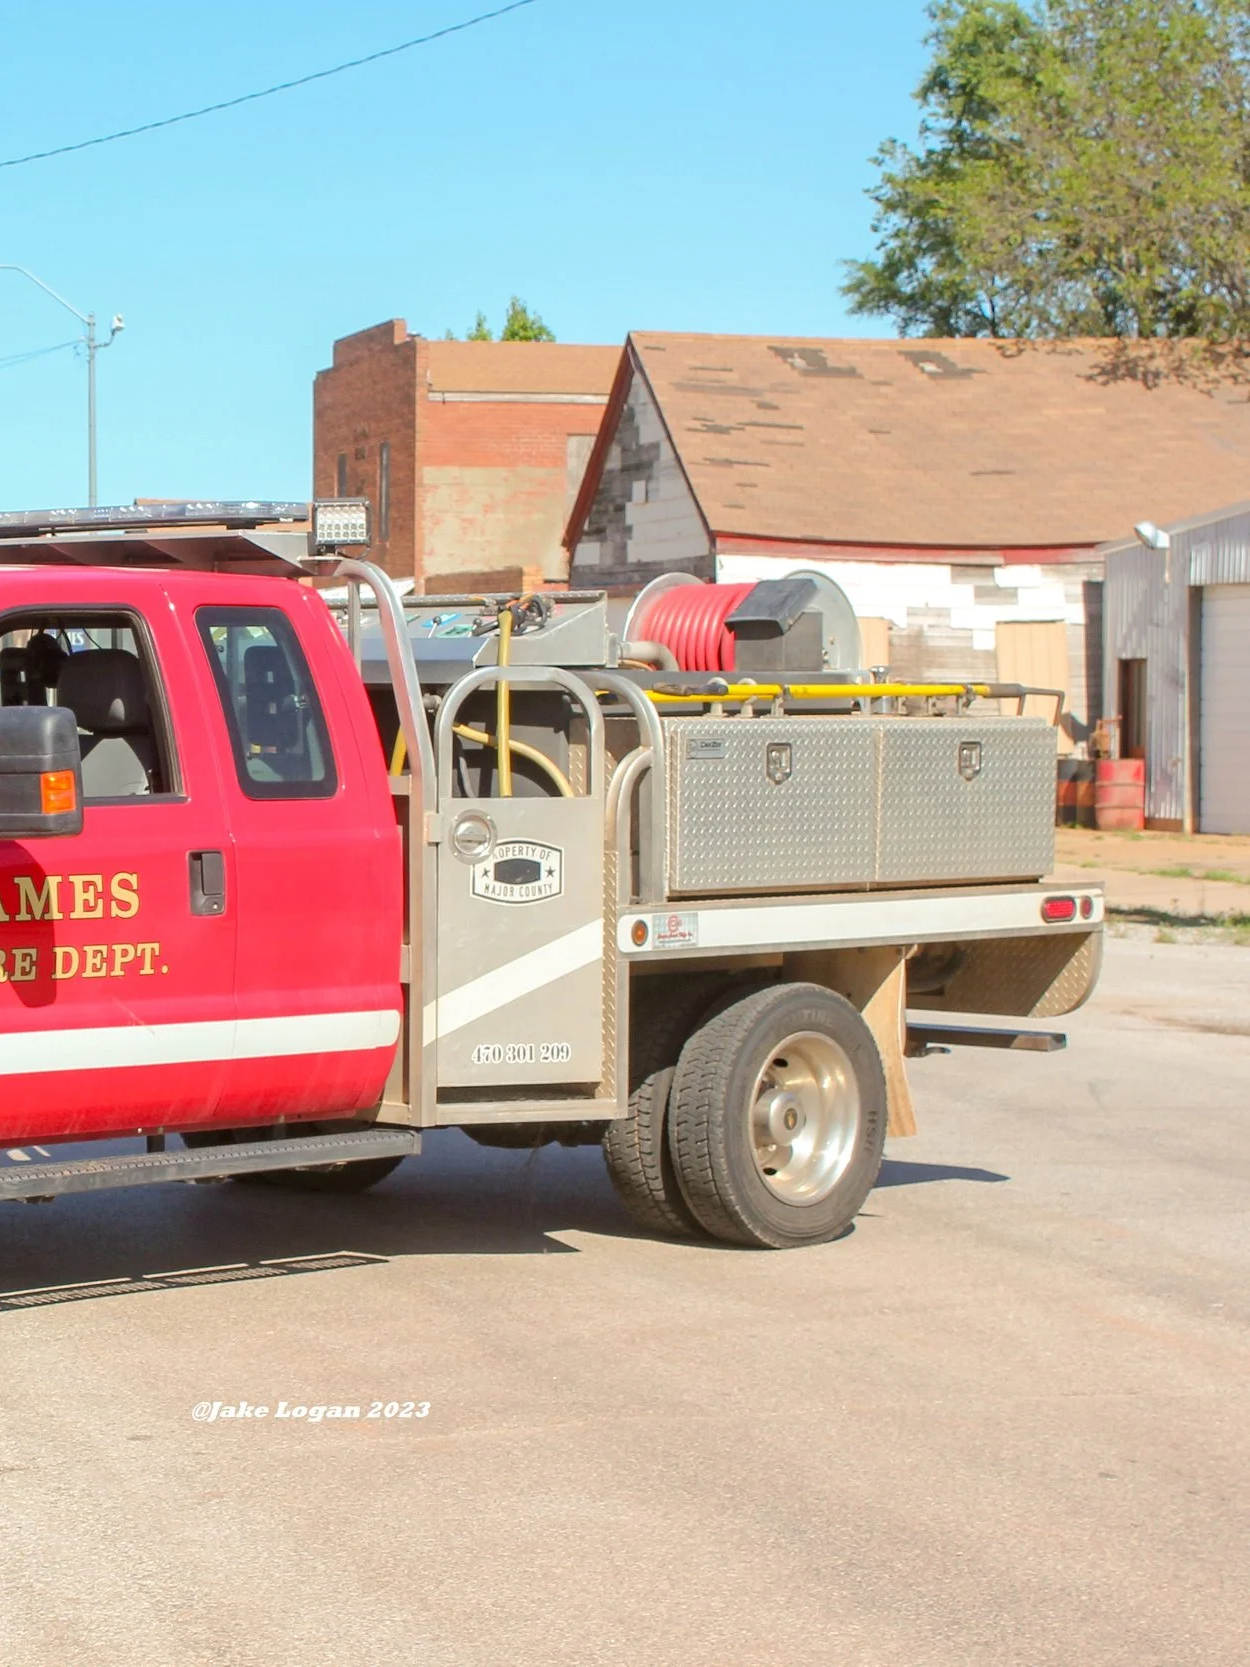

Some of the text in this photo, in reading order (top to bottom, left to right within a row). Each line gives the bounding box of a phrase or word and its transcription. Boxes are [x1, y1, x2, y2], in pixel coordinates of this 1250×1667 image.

[492, 845, 552, 861] OPERTY OF
[484, 883, 553, 898] MAJOR COUNTY
[51, 941, 170, 981] DEPT.
[471, 1043, 571, 1064] 470 301 209
